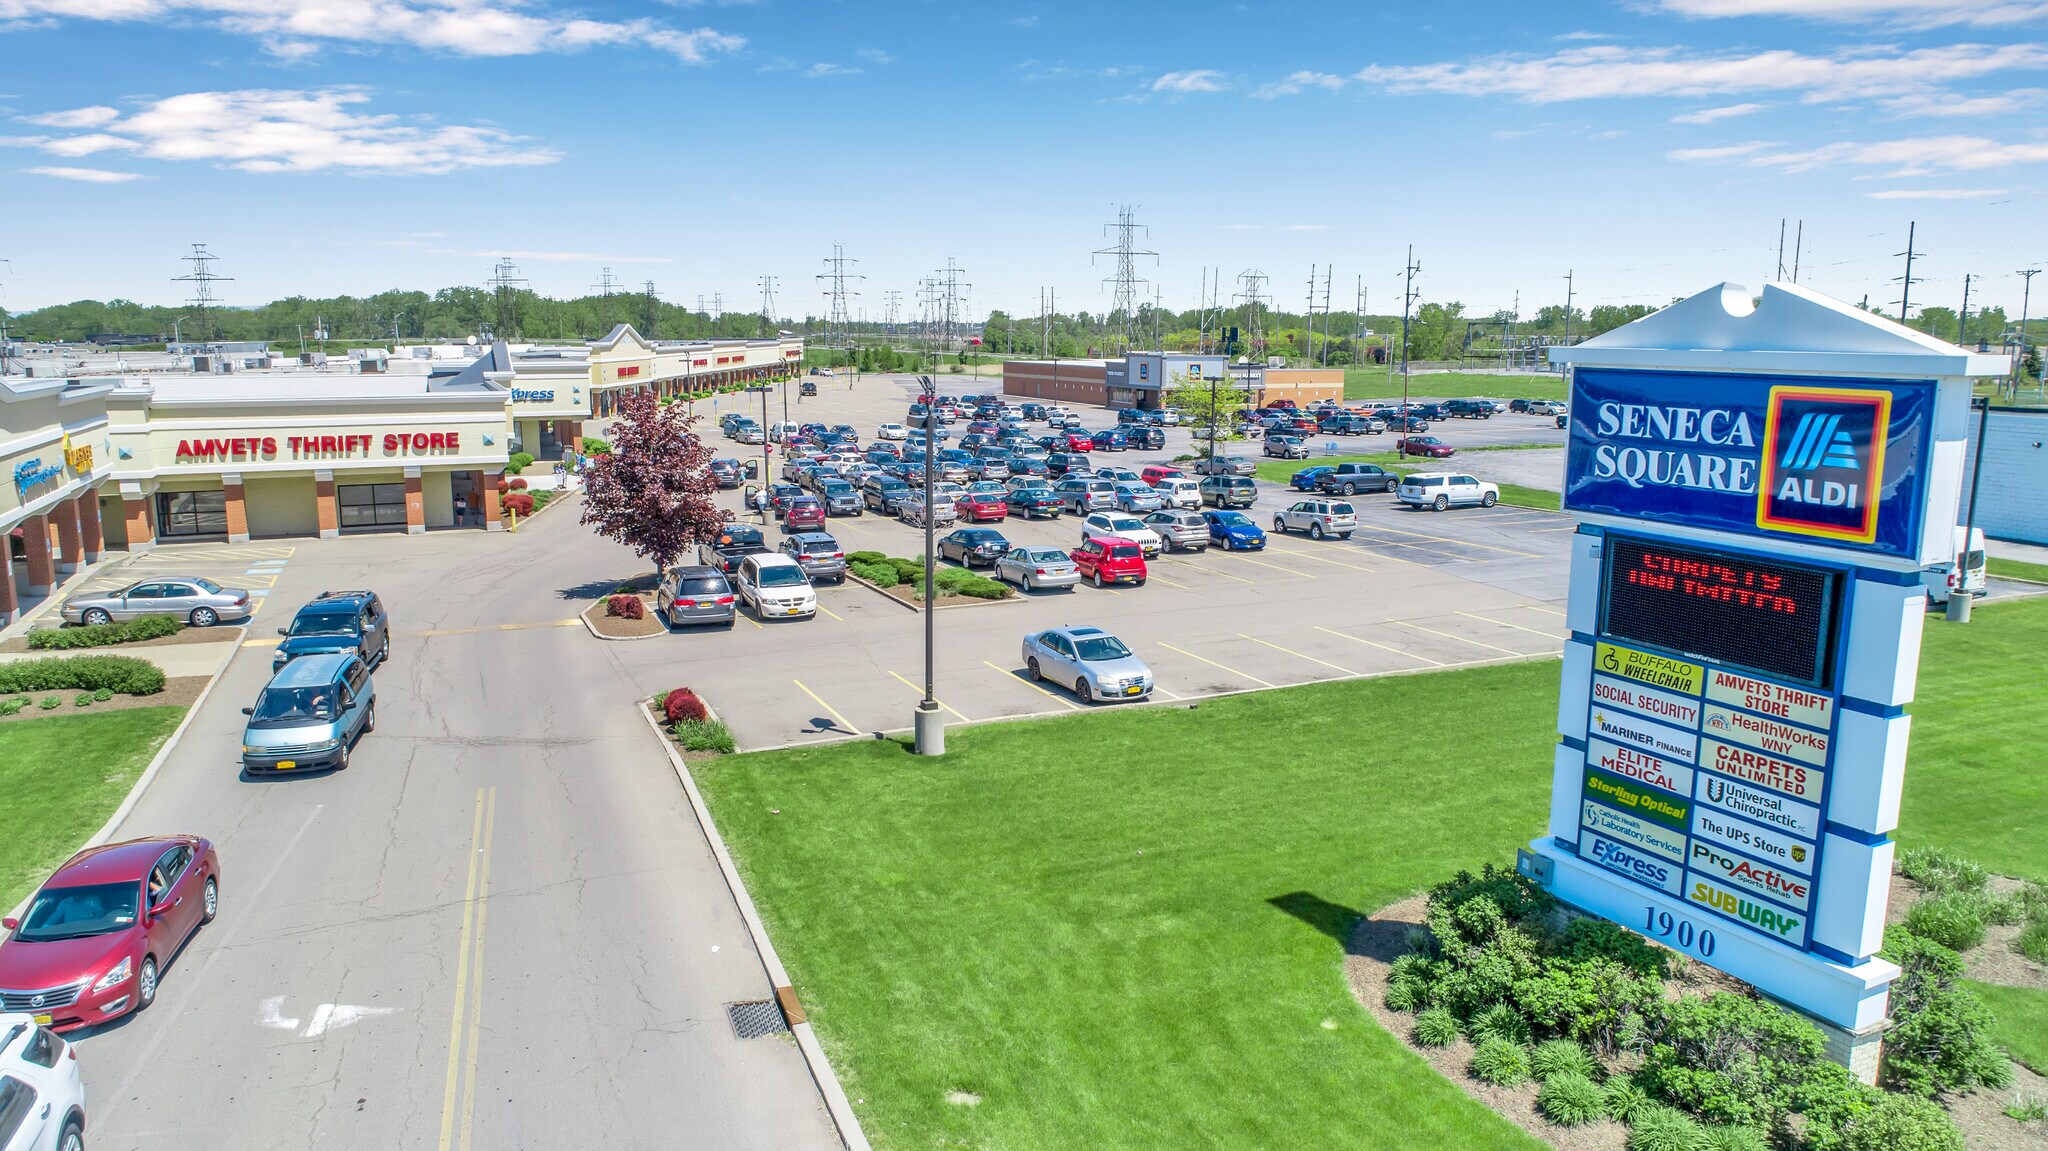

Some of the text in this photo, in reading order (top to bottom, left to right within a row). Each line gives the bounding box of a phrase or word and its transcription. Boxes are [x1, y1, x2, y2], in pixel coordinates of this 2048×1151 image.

[1597, 402, 1756, 448] SENECA
[176, 432, 460, 457] AMVETS THRIFT STORE
[1594, 446, 1756, 494] SQUARE
[1777, 476, 1857, 508] ALDI
[1624, 664, 1692, 692] WHEELCHAIR
[1628, 652, 1692, 676] BUFFALO
[1595, 683, 1696, 722] SOCIAL SECURITY
[1716, 673, 1828, 711] AMVETS THRIFT
[1745, 695, 1790, 718] STORE
[1602, 722, 1692, 758] MARINER FINANCE
[1732, 714, 1826, 750] HealthWorks
[1761, 736, 1792, 755] WNY
[1602, 756, 1676, 791] MEDICAL
[1618, 748, 1662, 772] ELITE
[1716, 745, 1806, 783] CARPETS
[1716, 760, 1805, 795] UNLIMITED
[1588, 776, 1686, 820] Sterling Optical
[1725, 796, 1796, 829] Chiropractic
[1726, 784, 1782, 812] Universal
[1599, 808, 1640, 829] Catholic Health
[1601, 818, 1682, 855] Laboratory Services
[1702, 818, 1786, 858] The UPS Store
[1693, 844, 1807, 898] ProActive
[1737, 875, 1791, 899] Sports Rehab
[1690, 883, 1800, 936] SUBWAY
[1644, 906, 1715, 957] 1900
